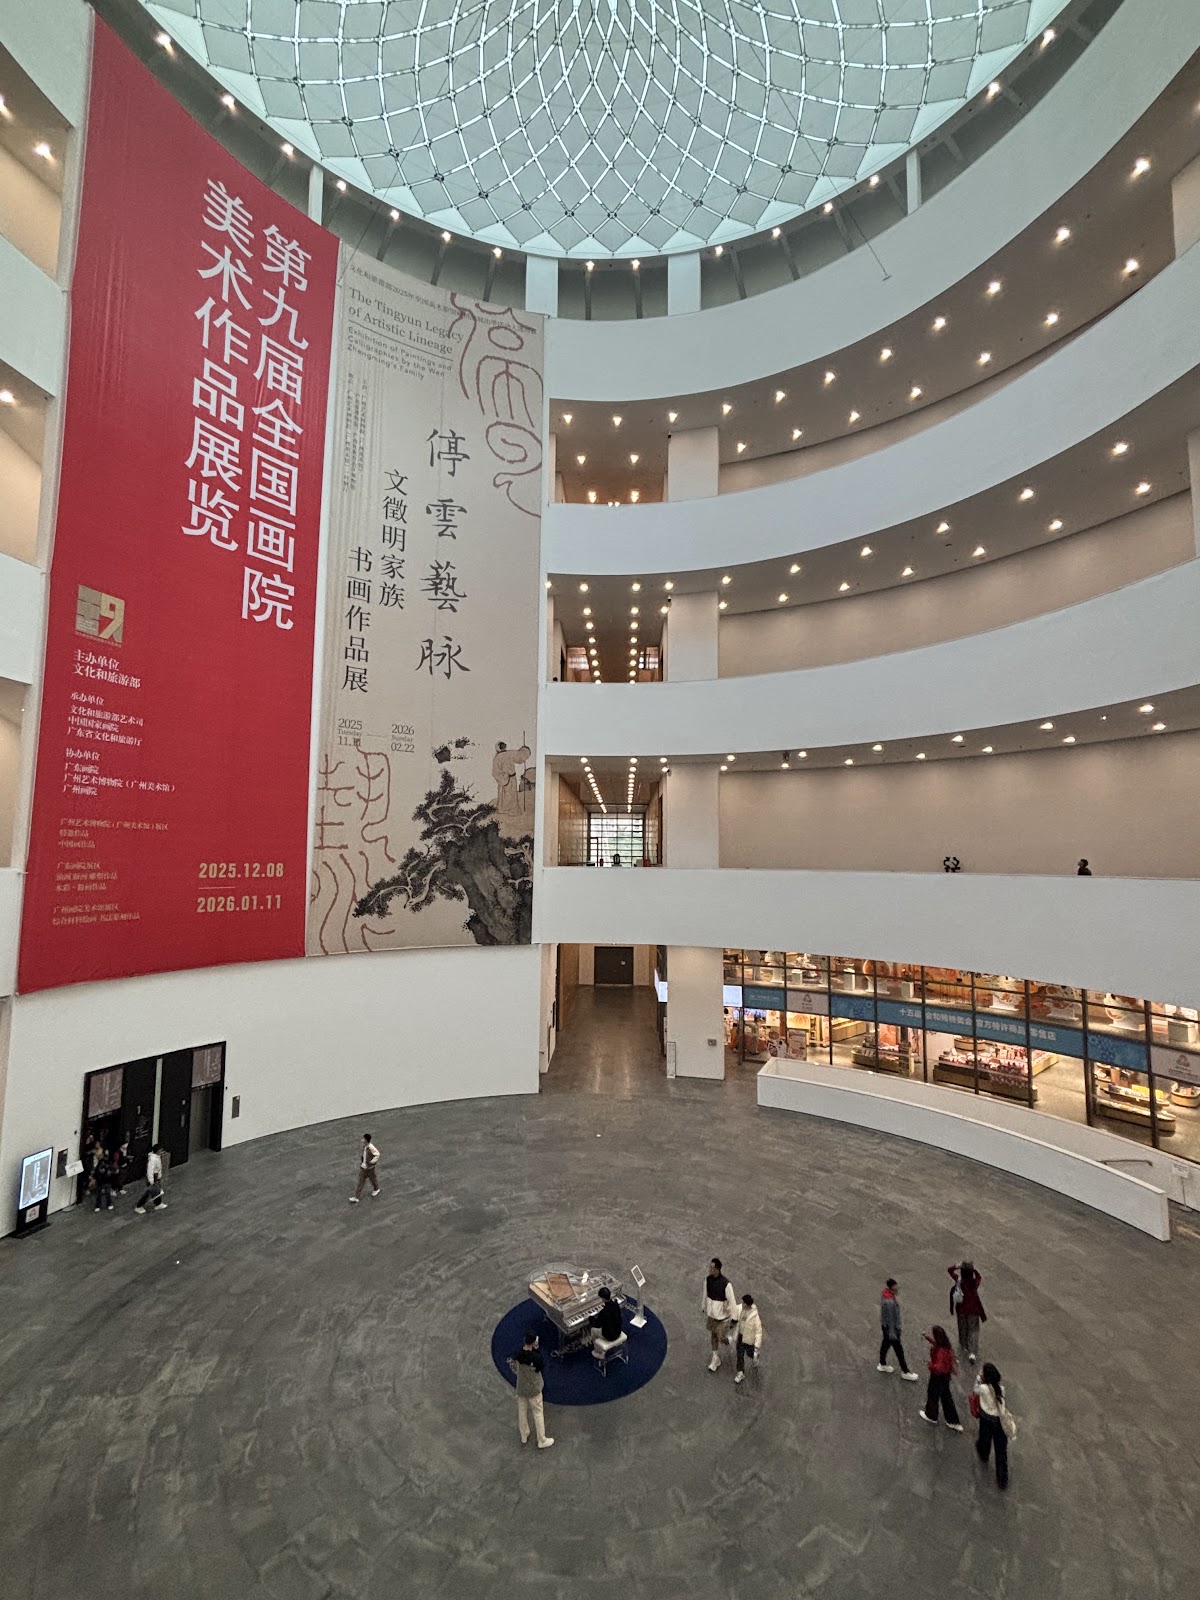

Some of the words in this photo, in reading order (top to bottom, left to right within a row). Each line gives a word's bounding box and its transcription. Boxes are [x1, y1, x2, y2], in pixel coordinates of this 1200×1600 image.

[350, 287, 372, 306] The
[374, 299, 422, 327] Tingyun
[425, 321, 464, 343] Legacy
[348, 306, 362, 318] of
[364, 312, 406, 337] Artistic
[408, 330, 453, 354] Lineage
[348, 326, 388, 348] Exhibition
[400, 348, 436, 367] Paintings
[438, 362, 452, 372] and
[182, 178, 254, 551] 美术作品展览
[347, 344, 397, 370] Zhengming's
[400, 365, 424, 380] Family
[401, 358, 410, 367] by
[413, 362, 426, 372] the
[428, 368, 445, 378] Wen
[241, 224, 312, 630] 第九届全国画院
[379, 469, 408, 610] 文徵明家族
[342, 547, 373, 693] 书画作品展
[74, 649, 120, 671] 主办单位
[73, 664, 141, 689] 文化和旅游部
[70, 691, 104, 706] 承办单位
[70, 705, 144, 727] 文化和旅游部艺术司
[338, 718, 362, 730] 2025
[67, 727, 142, 746] 广东省文化和旅游厅
[392, 724, 415, 735] 2026
[66, 747, 100, 761] 协办单位
[391, 742, 415, 753] 02.22
[198, 862, 284, 879] 2025.12.08
[196, 894, 282, 913] 2026.01.11
